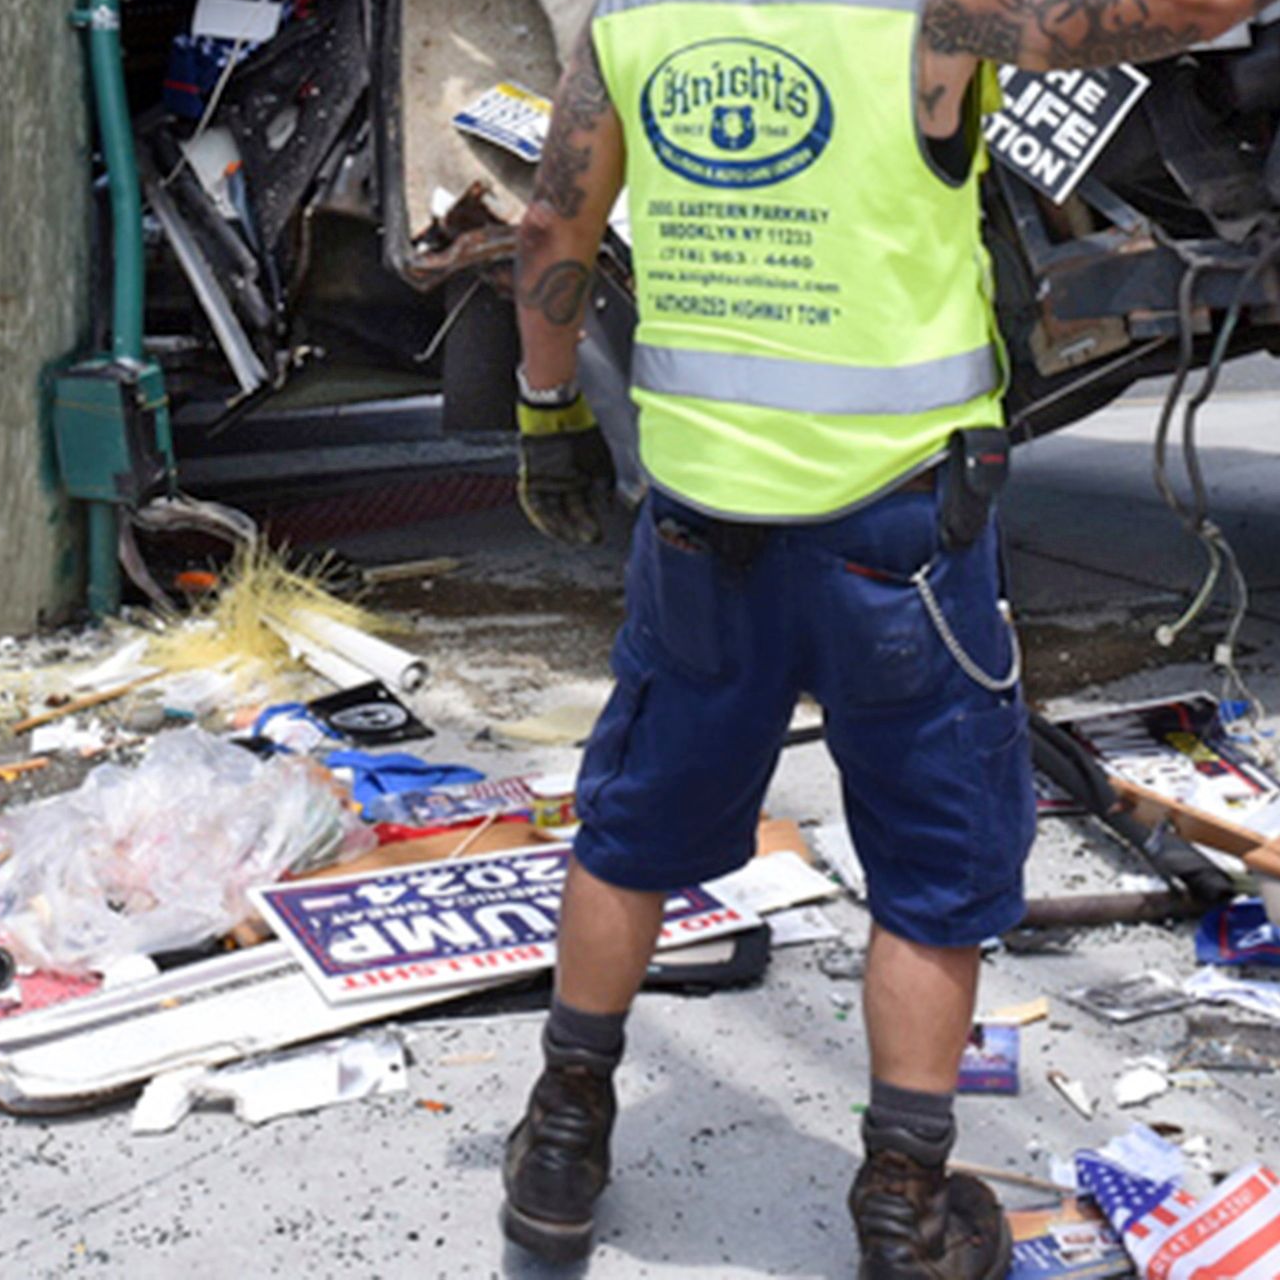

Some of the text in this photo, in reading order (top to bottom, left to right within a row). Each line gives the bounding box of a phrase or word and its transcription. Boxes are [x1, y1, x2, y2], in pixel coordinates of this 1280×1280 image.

[660, 55, 809, 119] Knight's
[980, 110, 1067, 187] TION
[660, 222, 813, 246] BROOKLYN NY 11233
[678, 200, 748, 219] EASTERN
[752, 204, 830, 223] PARKWAY
[660, 247, 704, 263] (718)
[355, 855, 568, 906] 2024
[341, 945, 545, 991] BULLSHIT
